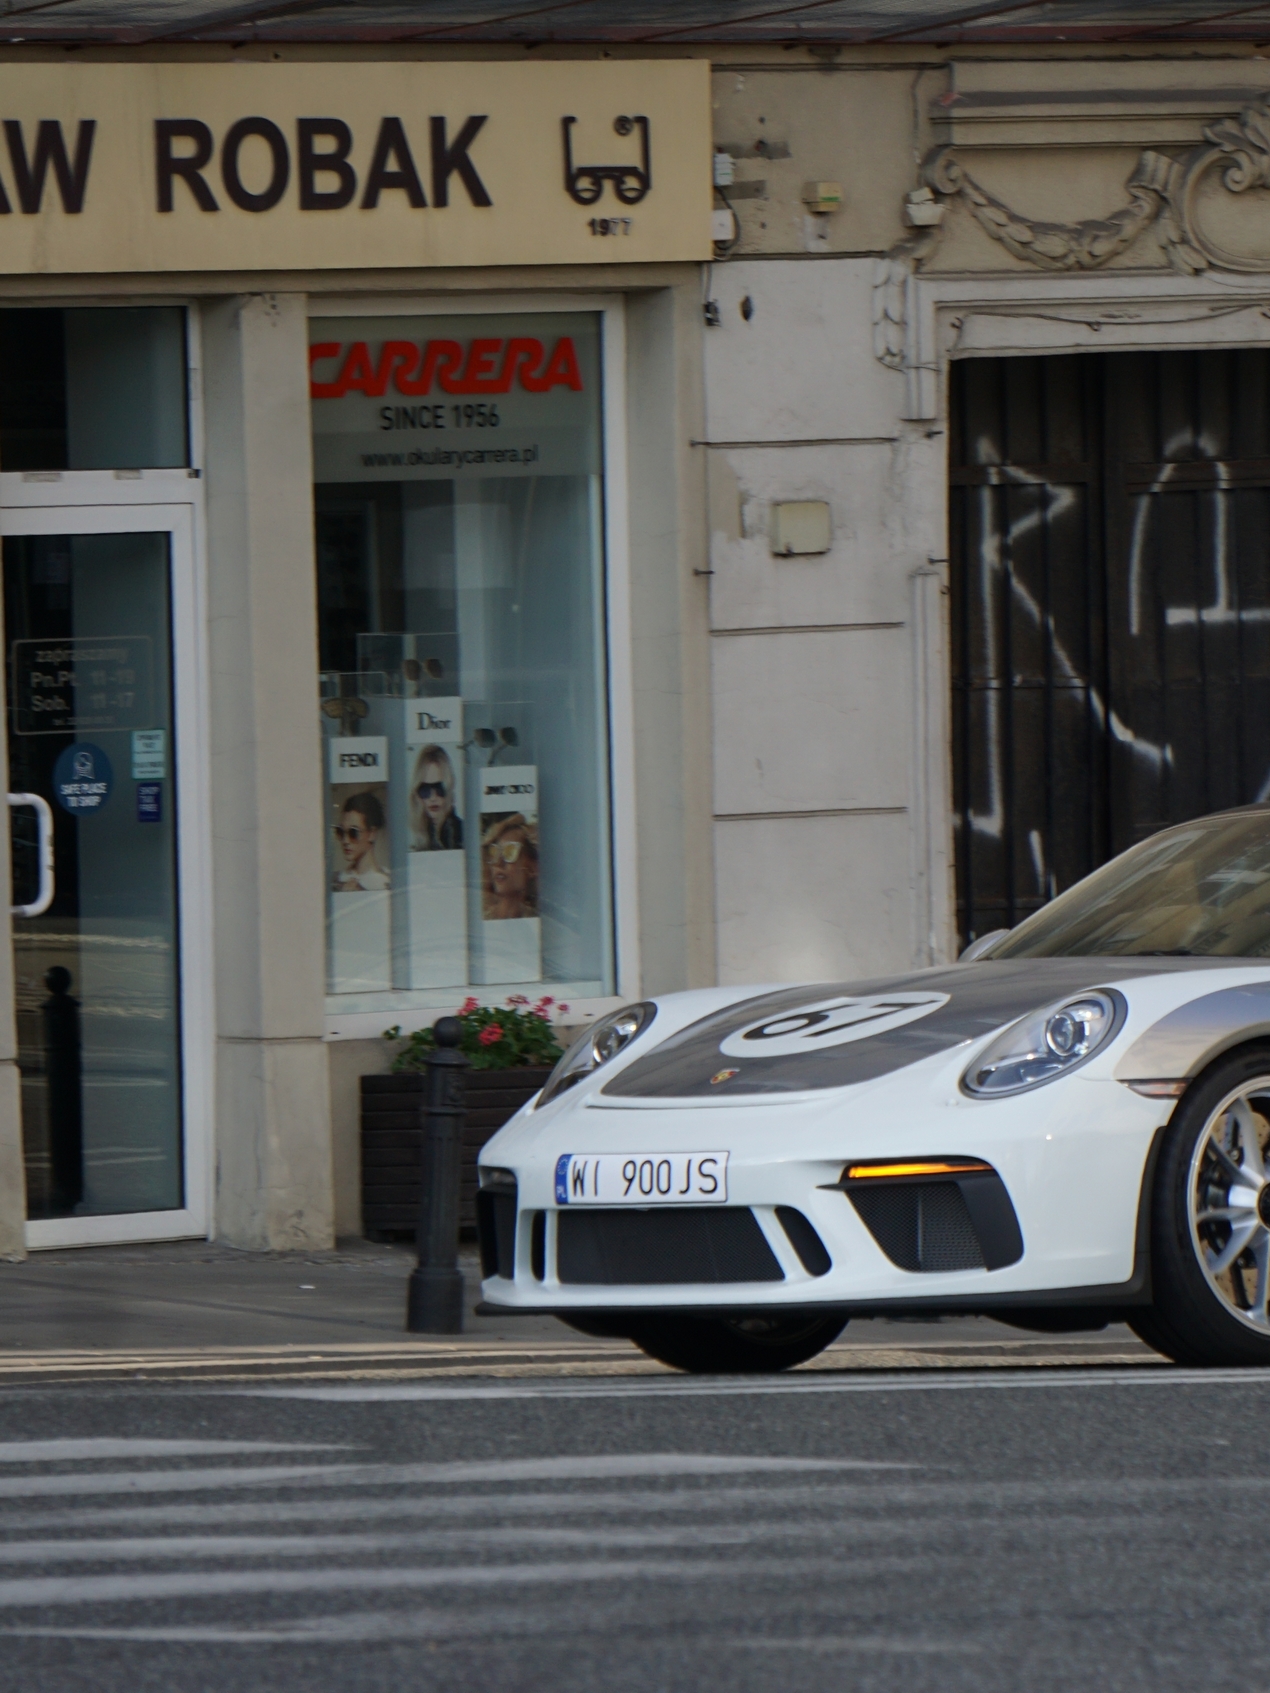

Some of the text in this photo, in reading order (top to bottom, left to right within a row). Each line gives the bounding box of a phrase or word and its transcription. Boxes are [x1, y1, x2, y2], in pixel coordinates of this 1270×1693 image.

[0, 115, 493, 214] W ROBAK
[587, 218, 633, 236] 1977
[310, 336, 584, 399] CARRERA
[380, 403, 501, 431] SINCE 1956
[361, 444, 539, 469] www.okularycarrera.pl
[417, 712, 453, 731] Dior
[339, 752, 379, 768] FENDI
[742, 1000, 940, 1040] 67
[572, 1157, 719, 1197] WI 900 JS
